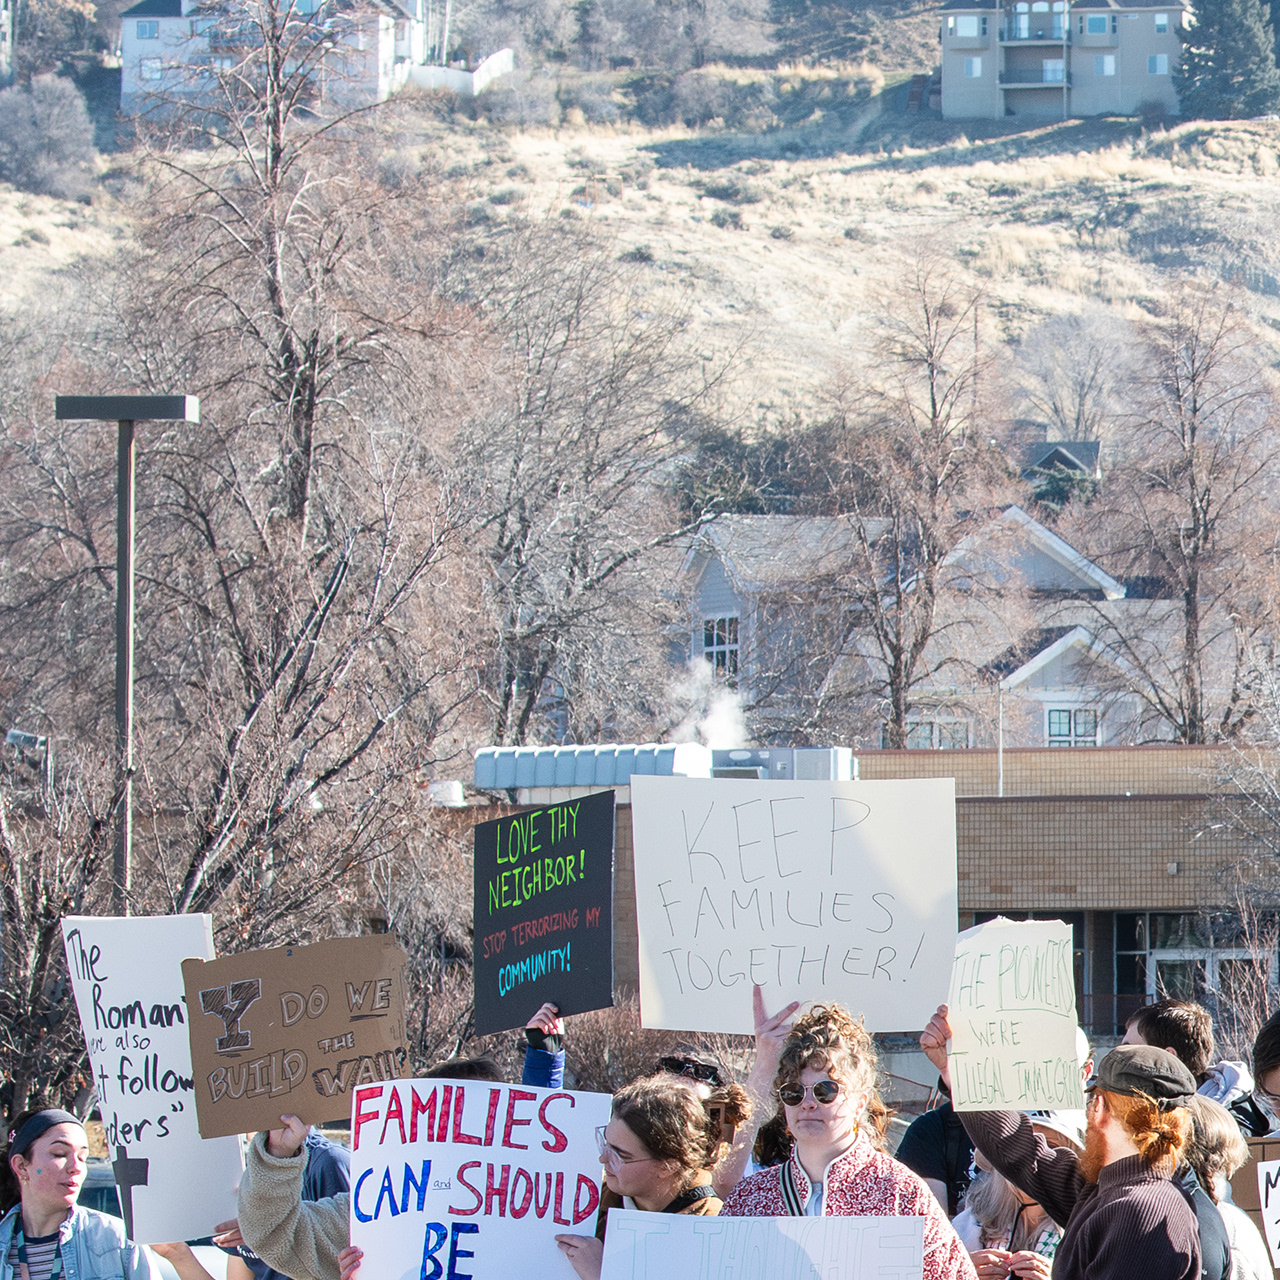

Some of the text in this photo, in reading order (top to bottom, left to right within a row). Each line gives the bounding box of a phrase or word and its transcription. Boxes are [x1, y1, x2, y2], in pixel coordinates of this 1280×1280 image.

[496, 802, 581, 864] LOVE THY
[681, 796, 871, 884] KEEP
[488, 849, 586, 916] NEIGHBOR!
[657, 879, 896, 939] FAMILIES
[67, 928, 108, 981] The
[482, 906, 601, 959] STOP TERRORIZING MY
[498, 941, 571, 997] COMMUNITY!
[662, 931, 926, 994] TOGETHER!
[92, 983, 186, 1030] Roman
[199, 978, 392, 1048] Y DO WE
[969, 1019, 1022, 1047] WERE
[115, 1030, 151, 1051] also
[317, 1032, 355, 1054] THE
[207, 1049, 308, 1103] BUILD
[353, 1085, 576, 1153] FAMILIES
[354, 1160, 600, 1226] CAN and SHOULD
